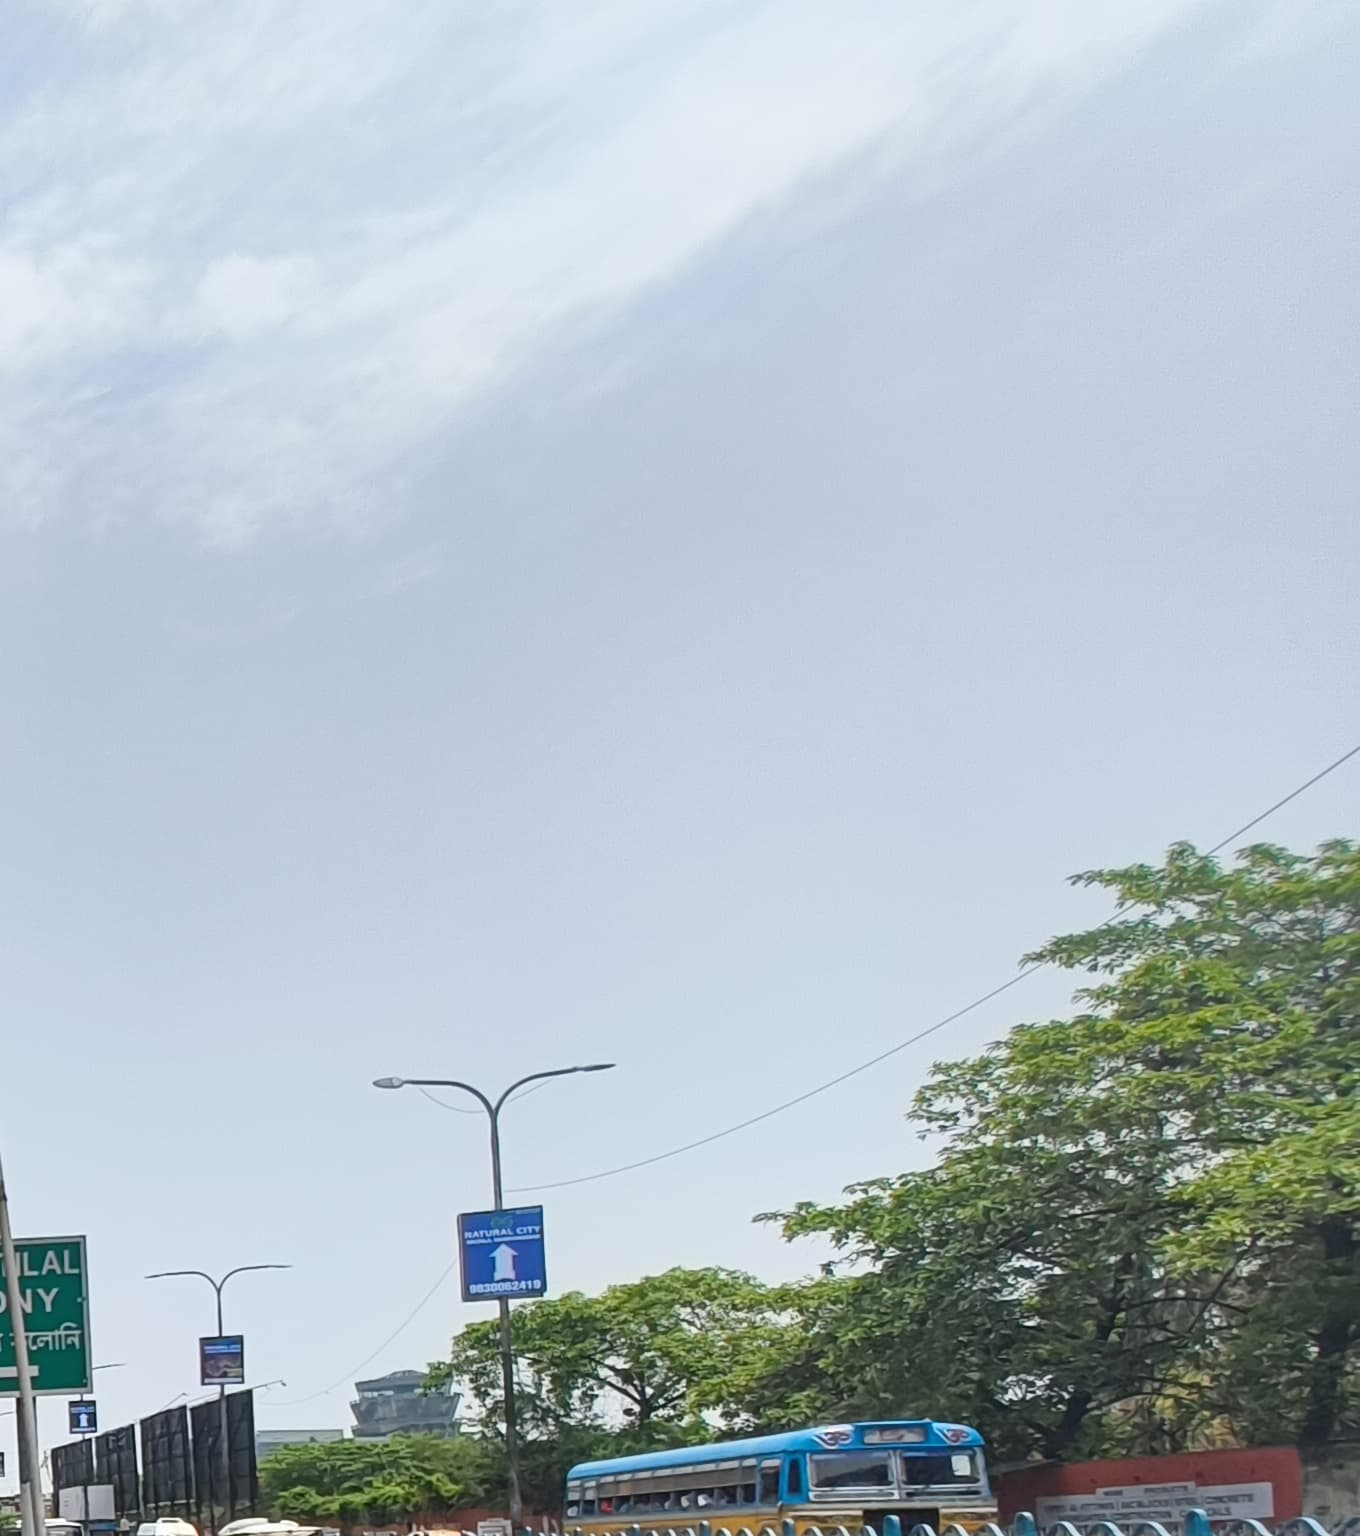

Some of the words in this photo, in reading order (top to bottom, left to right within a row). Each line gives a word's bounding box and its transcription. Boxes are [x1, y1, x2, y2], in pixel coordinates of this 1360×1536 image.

[464, 1228, 515, 1240] NATURAL
[516, 1225, 541, 1236] CITY
[10, 1322, 82, 1351] লোনি
